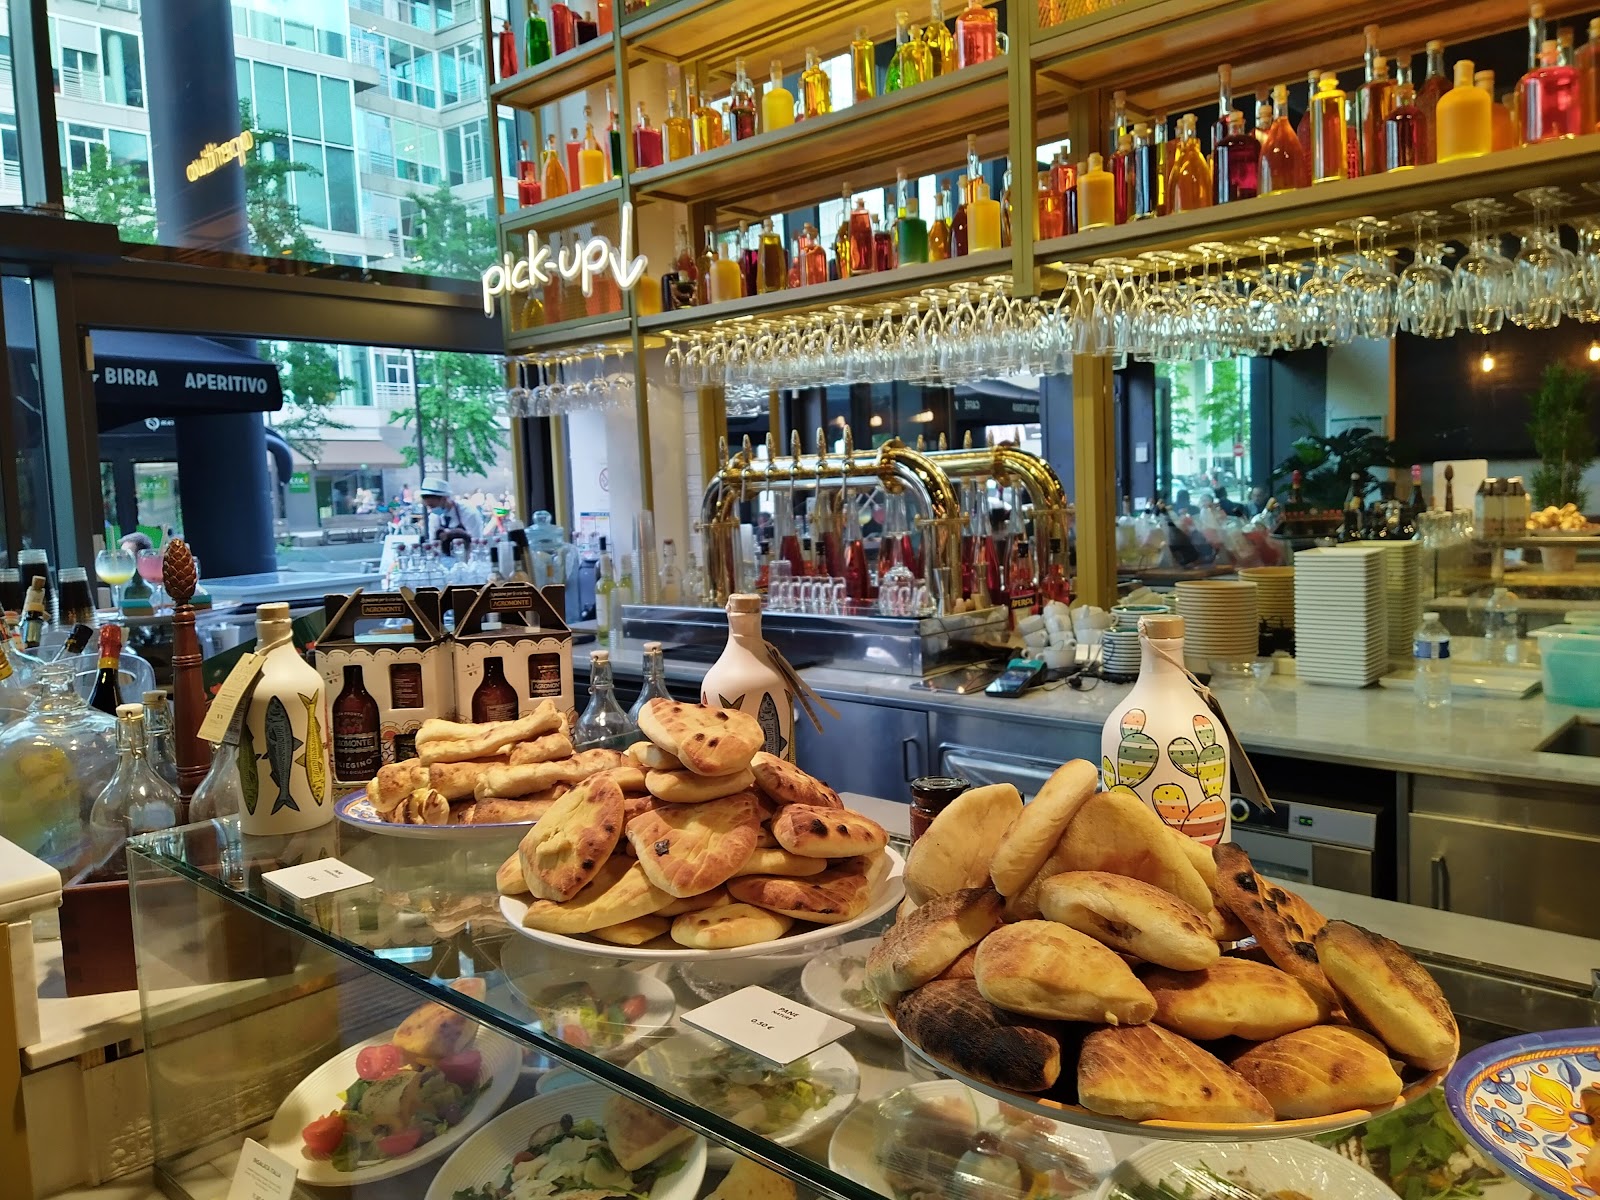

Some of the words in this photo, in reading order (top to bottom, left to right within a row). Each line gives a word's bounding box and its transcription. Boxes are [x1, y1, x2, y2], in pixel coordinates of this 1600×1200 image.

[481, 229, 610, 319] pick-up
[105, 367, 158, 387] BIRRA
[185, 372, 268, 394] APERITIVO
[1011, 597, 1034, 608] APEROL
[533, 682, 560, 690] AGROMON
[778, 1007, 799, 1017] PANE
